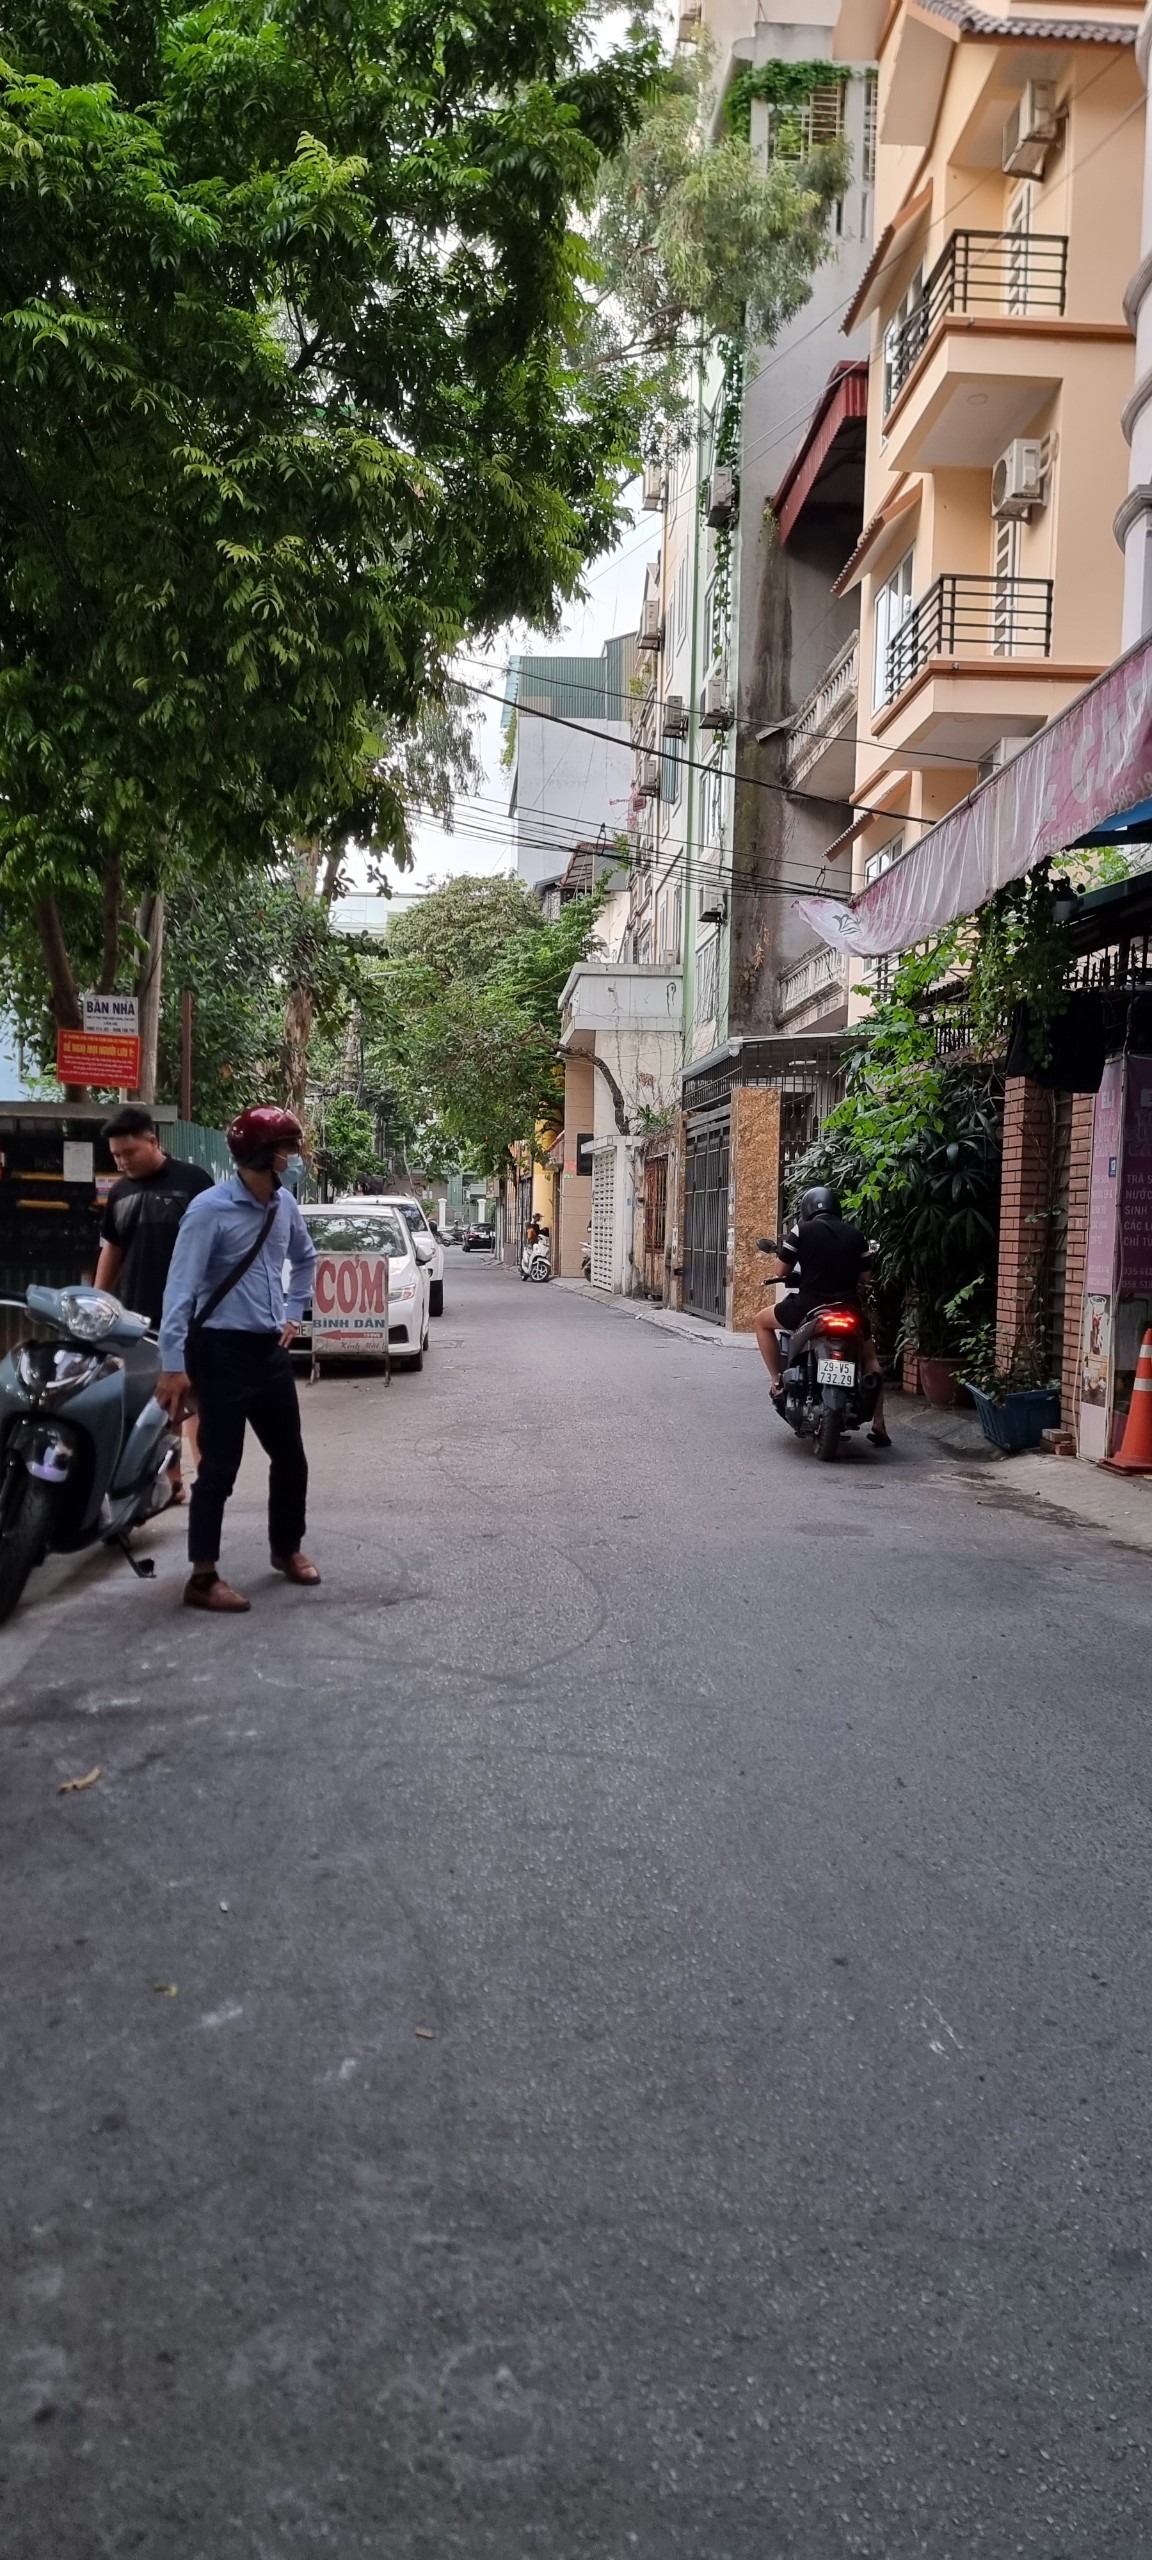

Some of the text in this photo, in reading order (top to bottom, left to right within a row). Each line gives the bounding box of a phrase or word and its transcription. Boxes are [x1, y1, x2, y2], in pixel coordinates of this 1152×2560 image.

[87, 998, 135, 1015] BÁN NHÀ
[1127, 1174, 1144, 1185] TRÀ
[1124, 1205, 1148, 1216] SINH
[1124, 1218, 1142, 1231] CÁC
[316, 1254, 385, 1314] CƠM
[313, 1317, 385, 1328] BÌNH DÂN
[824, 1362, 850, 1374] 29-V5
[820, 1372, 852, 1385] 732.29
